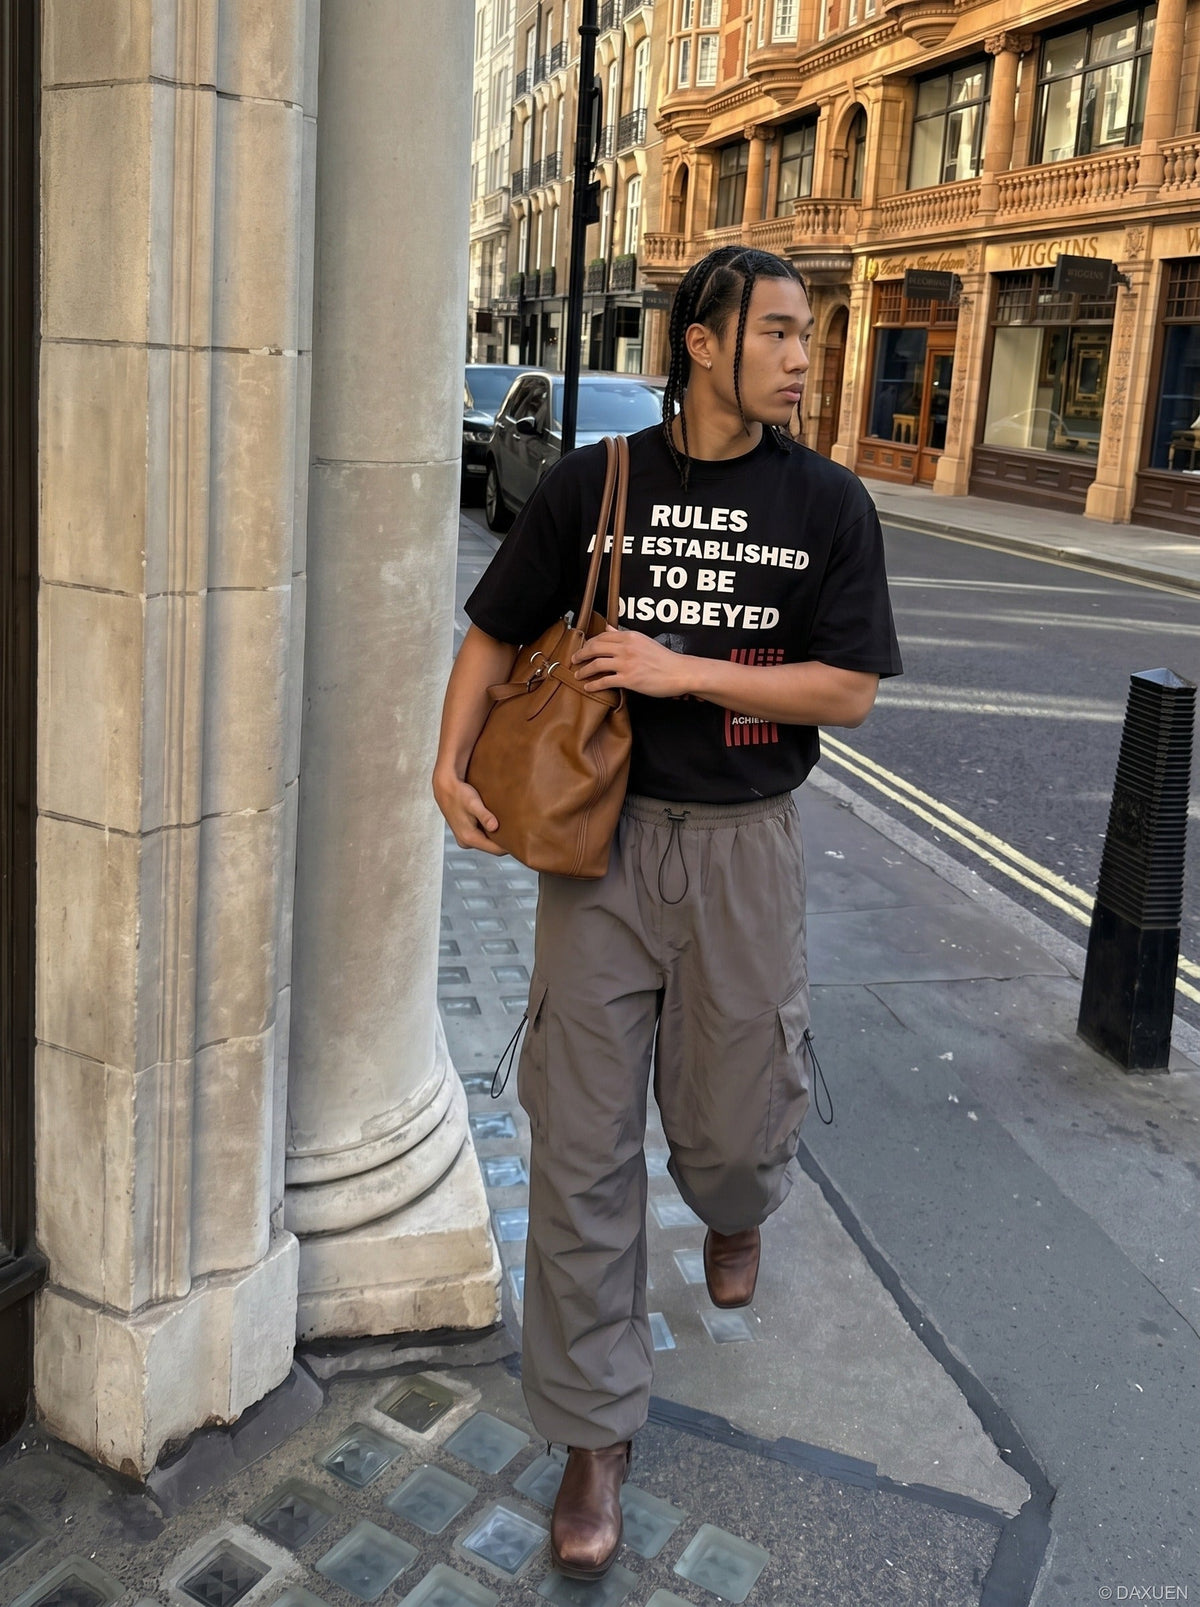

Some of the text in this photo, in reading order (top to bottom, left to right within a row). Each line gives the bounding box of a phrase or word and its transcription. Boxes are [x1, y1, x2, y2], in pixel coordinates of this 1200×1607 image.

[651, 504, 748, 532] RULES
[641, 536, 810, 570] ESTABLISHED
[650, 565, 736, 593] TO BE
